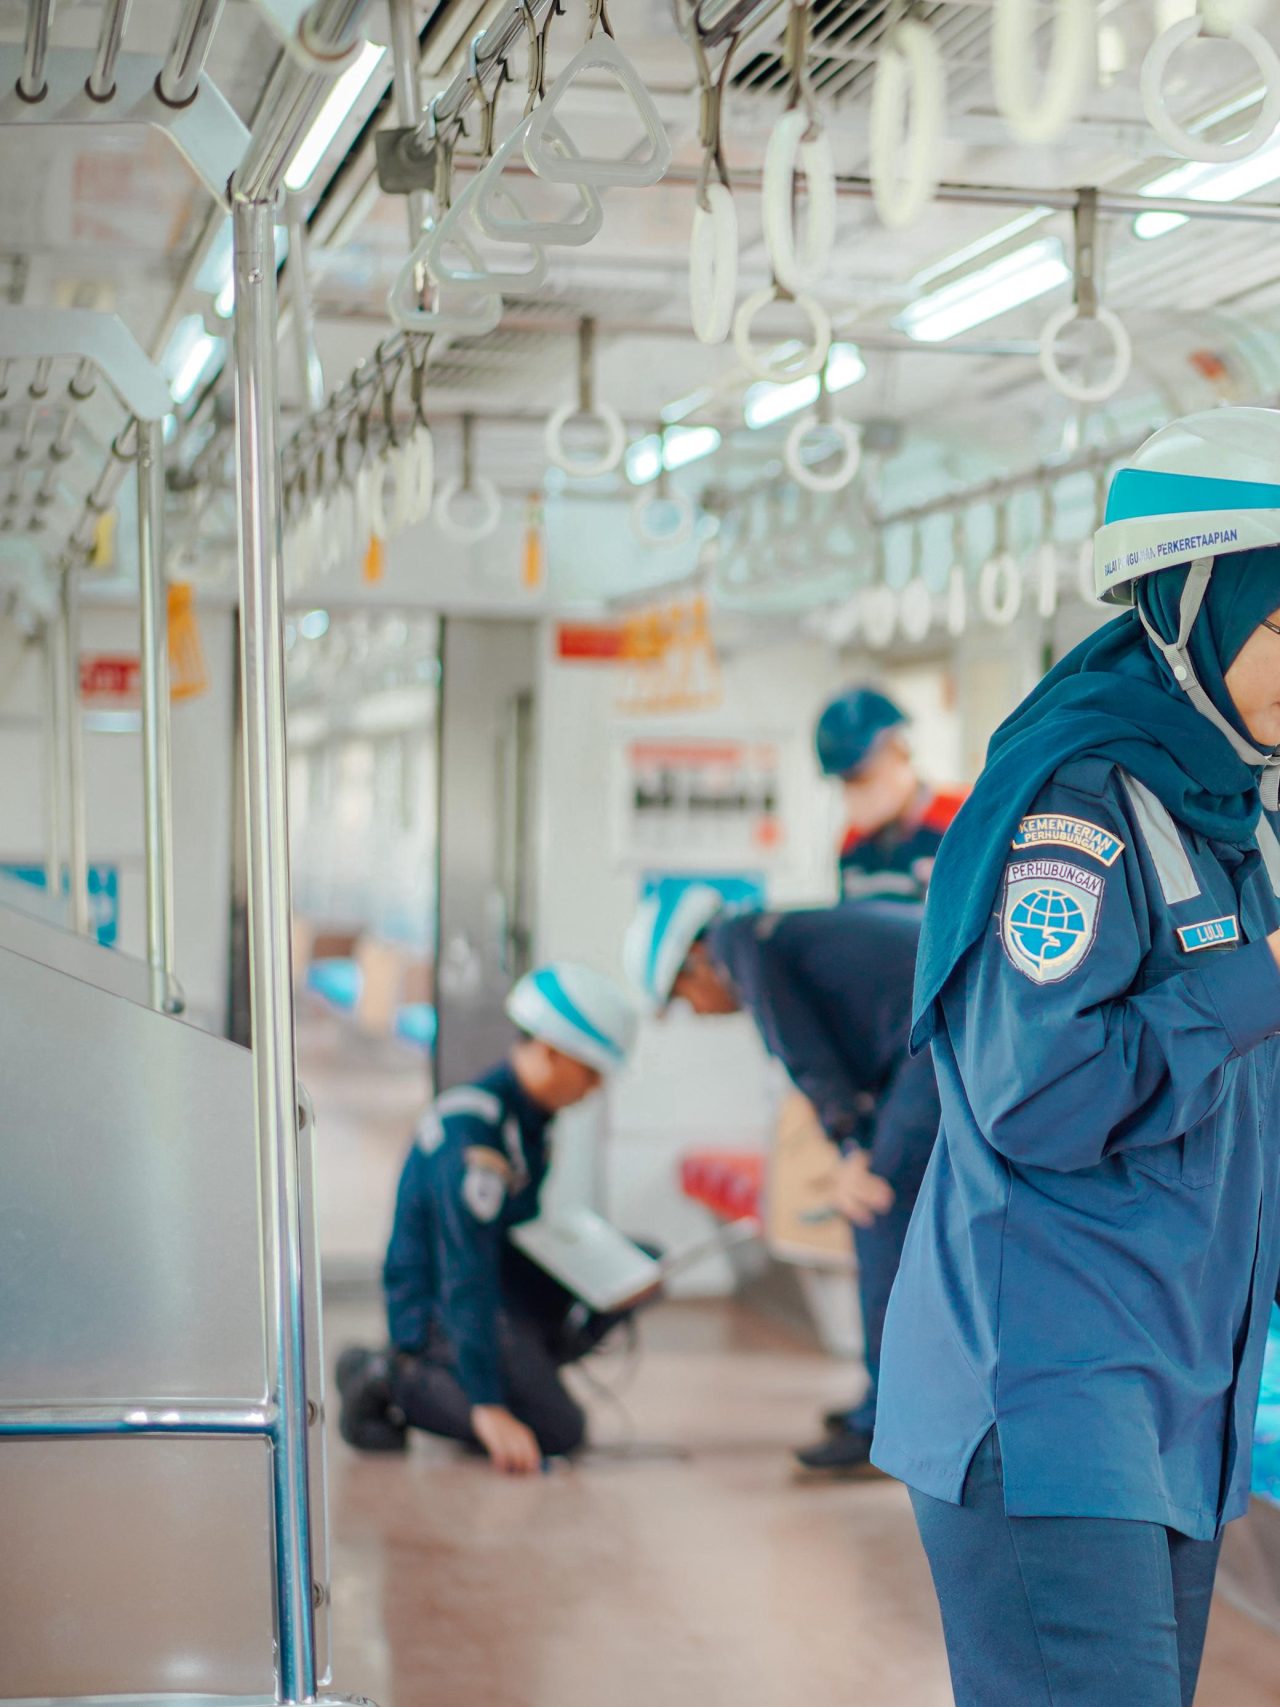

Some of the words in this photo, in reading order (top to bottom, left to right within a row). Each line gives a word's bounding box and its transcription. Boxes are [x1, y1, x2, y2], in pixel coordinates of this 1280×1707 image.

[1157, 528, 1238, 557] PERKERETAAPIAN
[1019, 818, 1113, 851] KEMENTERIAN
[1023, 830, 1104, 855] PERHUBUNGAN
[1012, 862, 1101, 892] PERHUBUNGAN
[1196, 922, 1225, 943] LULU
